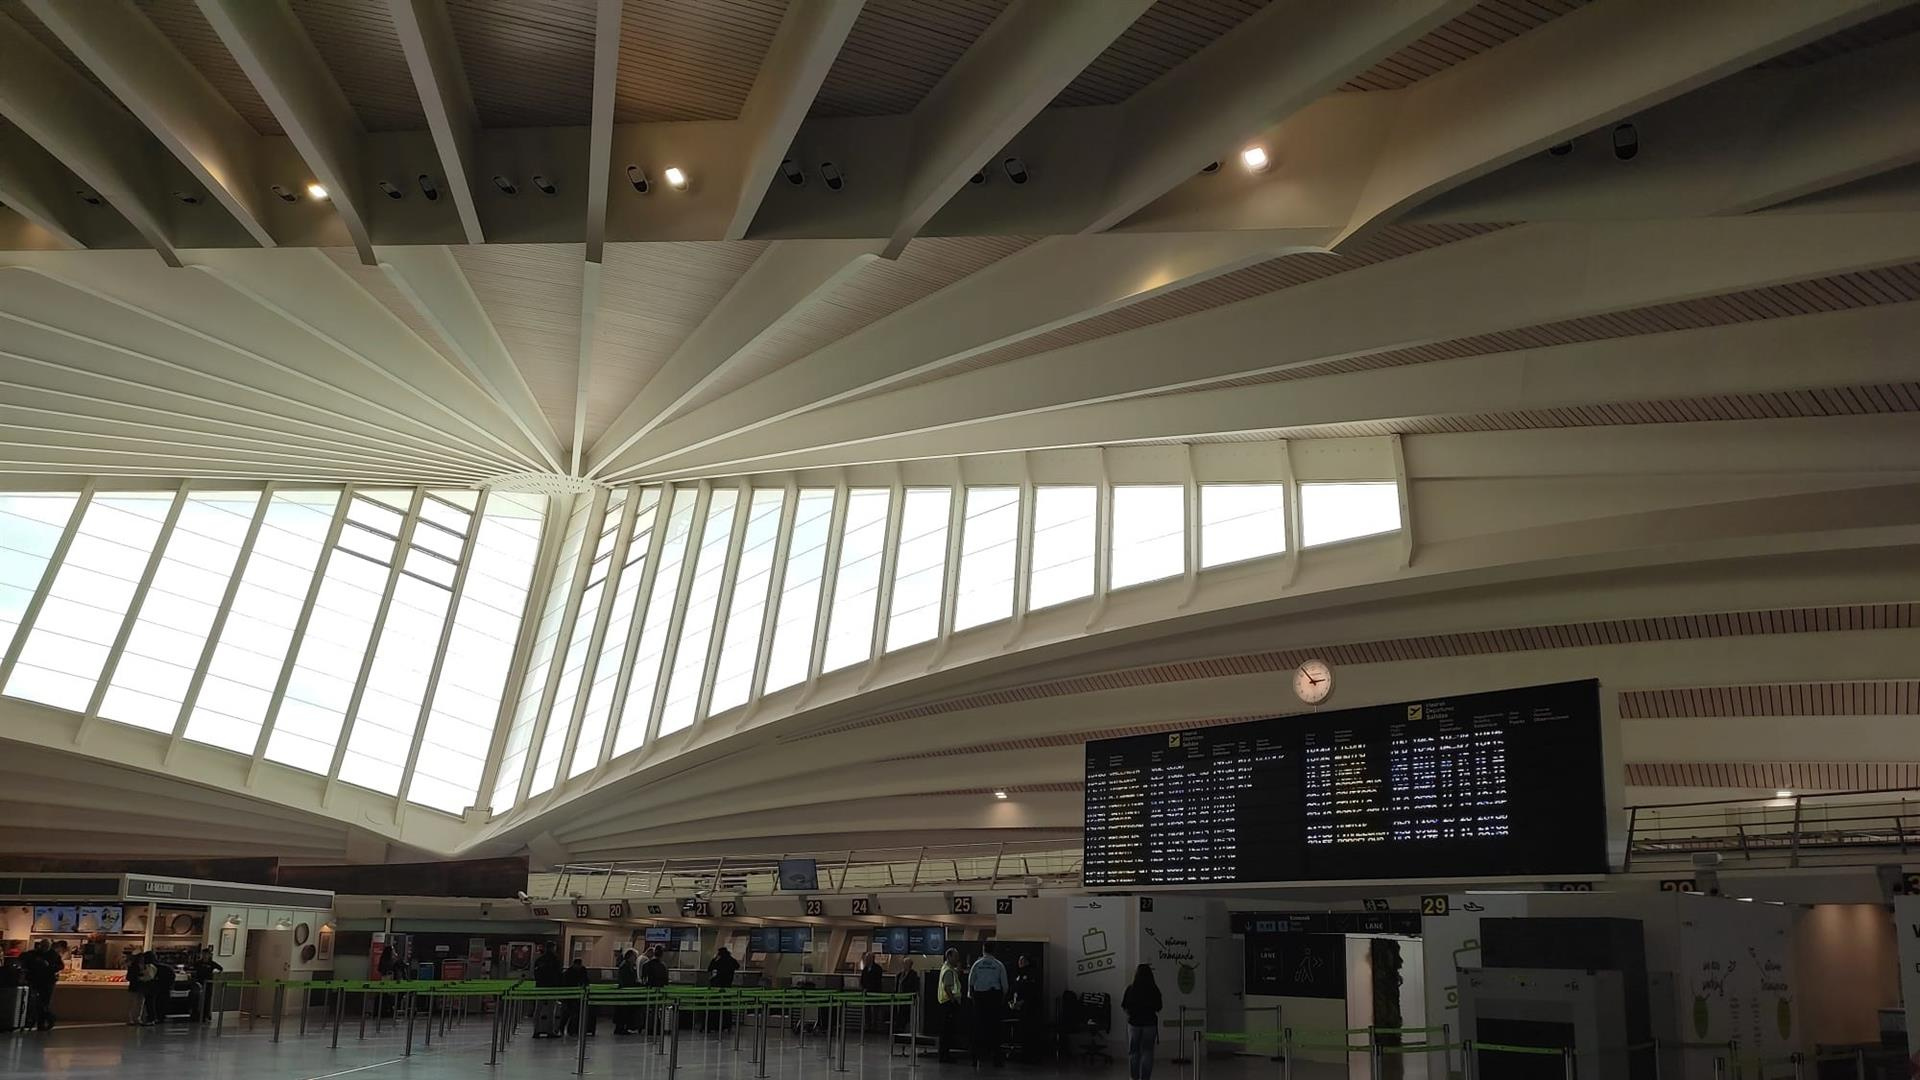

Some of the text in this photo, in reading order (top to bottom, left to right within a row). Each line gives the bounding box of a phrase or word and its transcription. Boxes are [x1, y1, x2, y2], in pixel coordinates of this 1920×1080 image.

[577, 905, 588, 917] 19
[610, 905, 621, 917] 20
[696, 903, 708, 915] 21
[722, 902, 735, 915] 22
[808, 902, 821, 915] 23
[853, 900, 868, 913] 24
[955, 898, 970, 912] 25
[998, 901, 1010, 912] 27
[1422, 897, 1447, 914] 29
